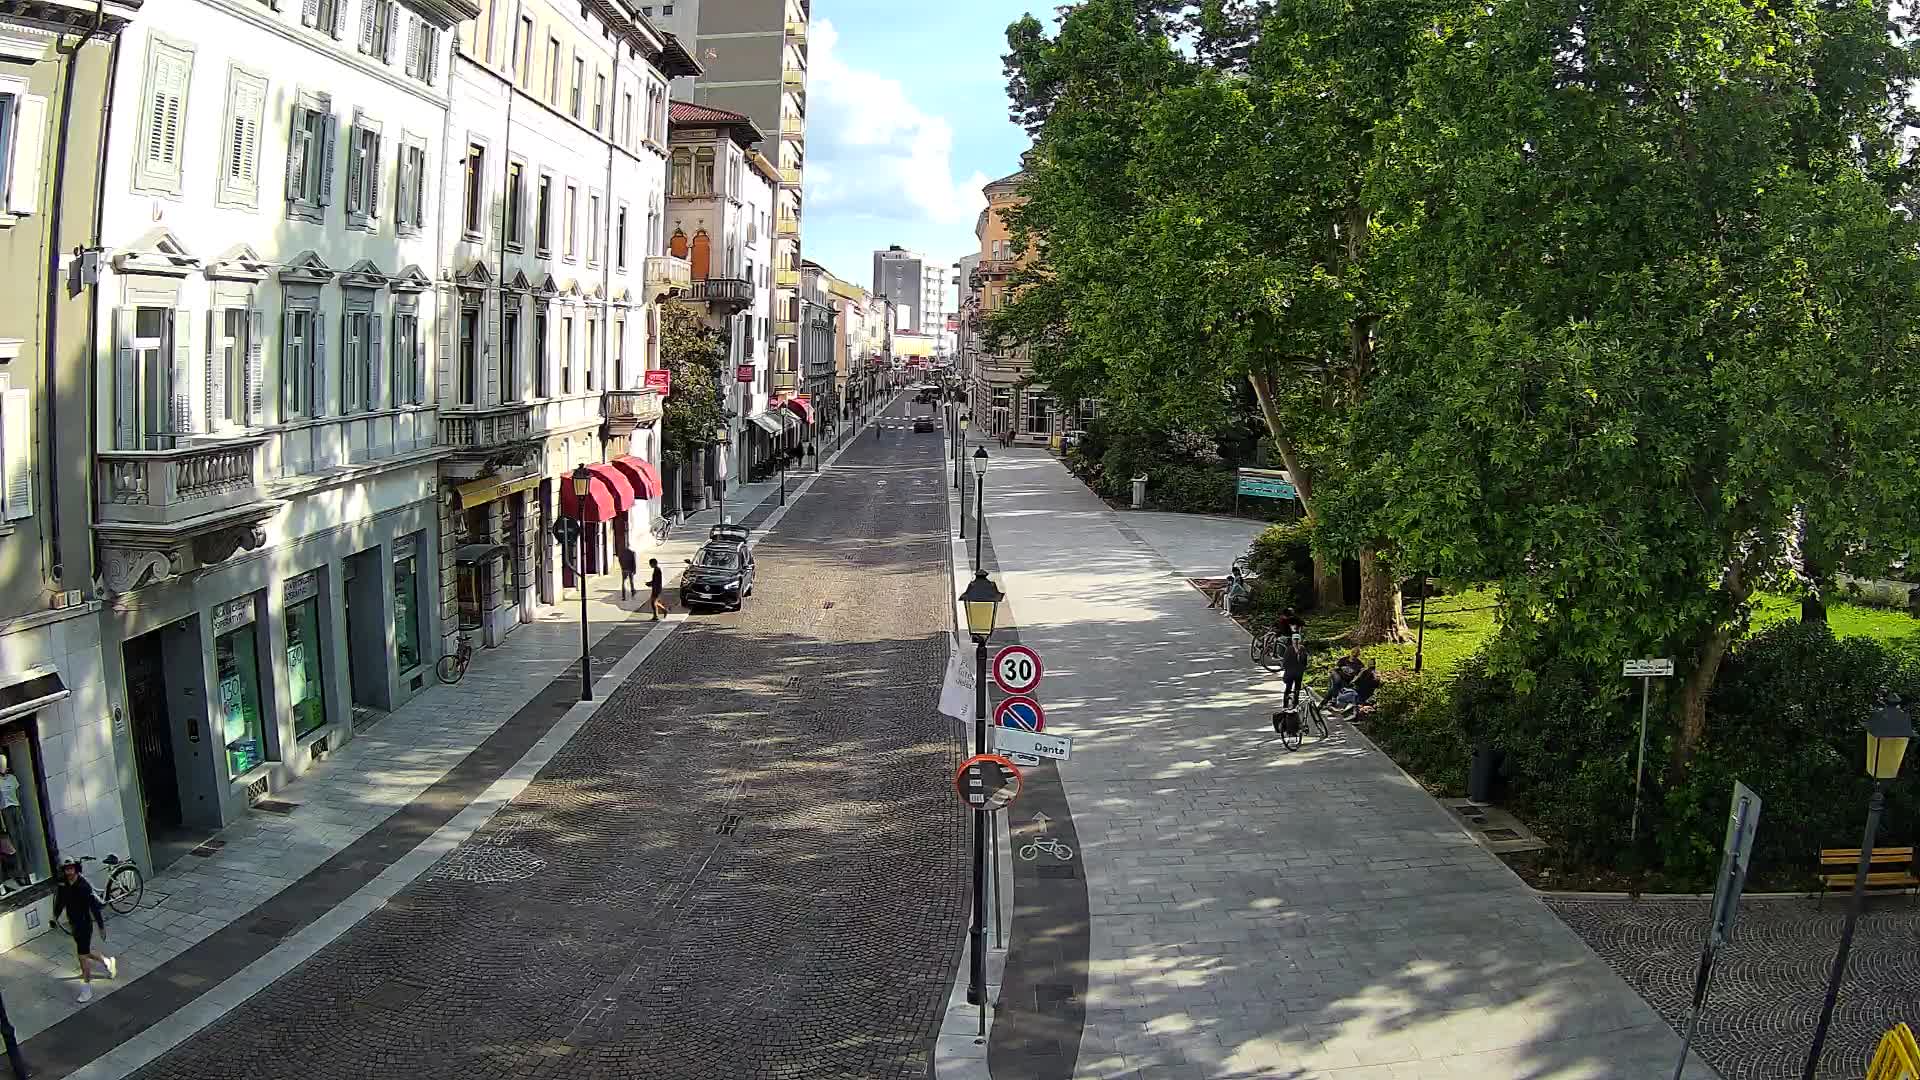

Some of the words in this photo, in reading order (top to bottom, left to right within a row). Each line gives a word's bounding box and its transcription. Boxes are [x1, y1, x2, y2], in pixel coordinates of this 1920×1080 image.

[288, 647, 304, 666] 130
[1005, 659, 1031, 681] 30
[221, 678, 239, 701] 130
[1035, 742, 1065, 755] Dante
